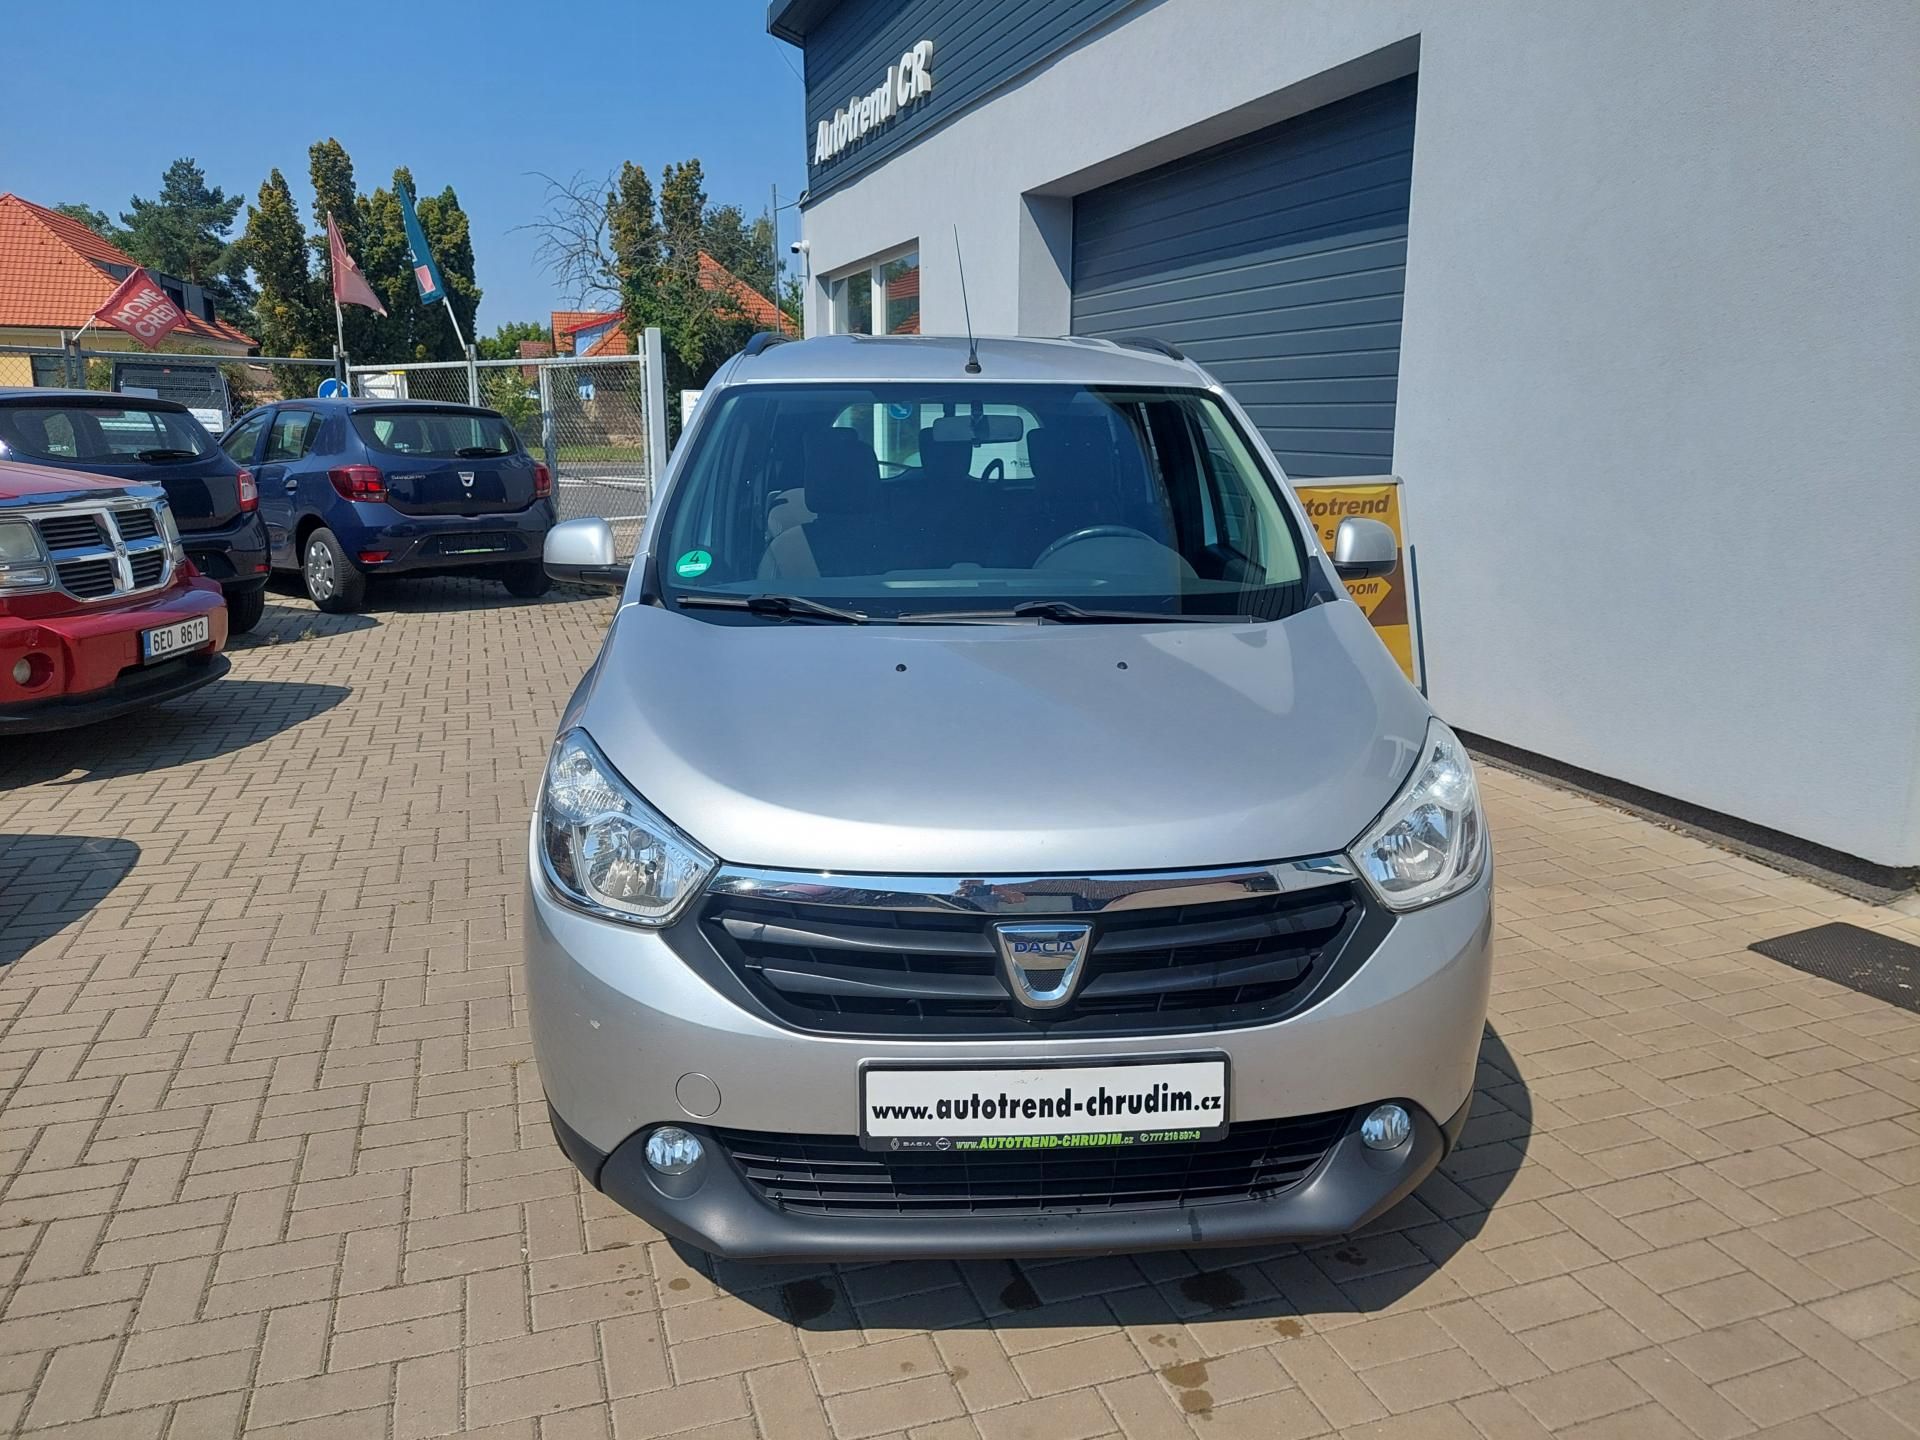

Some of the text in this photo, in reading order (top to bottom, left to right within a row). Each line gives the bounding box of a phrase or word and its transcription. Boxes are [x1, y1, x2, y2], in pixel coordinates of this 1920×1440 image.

[814, 40, 933, 165] Autotrend CR
[112, 288, 163, 326] HOME
[689, 551, 700, 564] 4
[1346, 583, 1379, 596] OOM
[180, 621, 204, 644] 8613
[1014, 941, 1076, 953] DACIA
[871, 1082, 1222, 1120] www.autotrend-chrudim.cz
[956, 1131, 1134, 1150] www.AUTOTREND-CHRUDIM.cz
